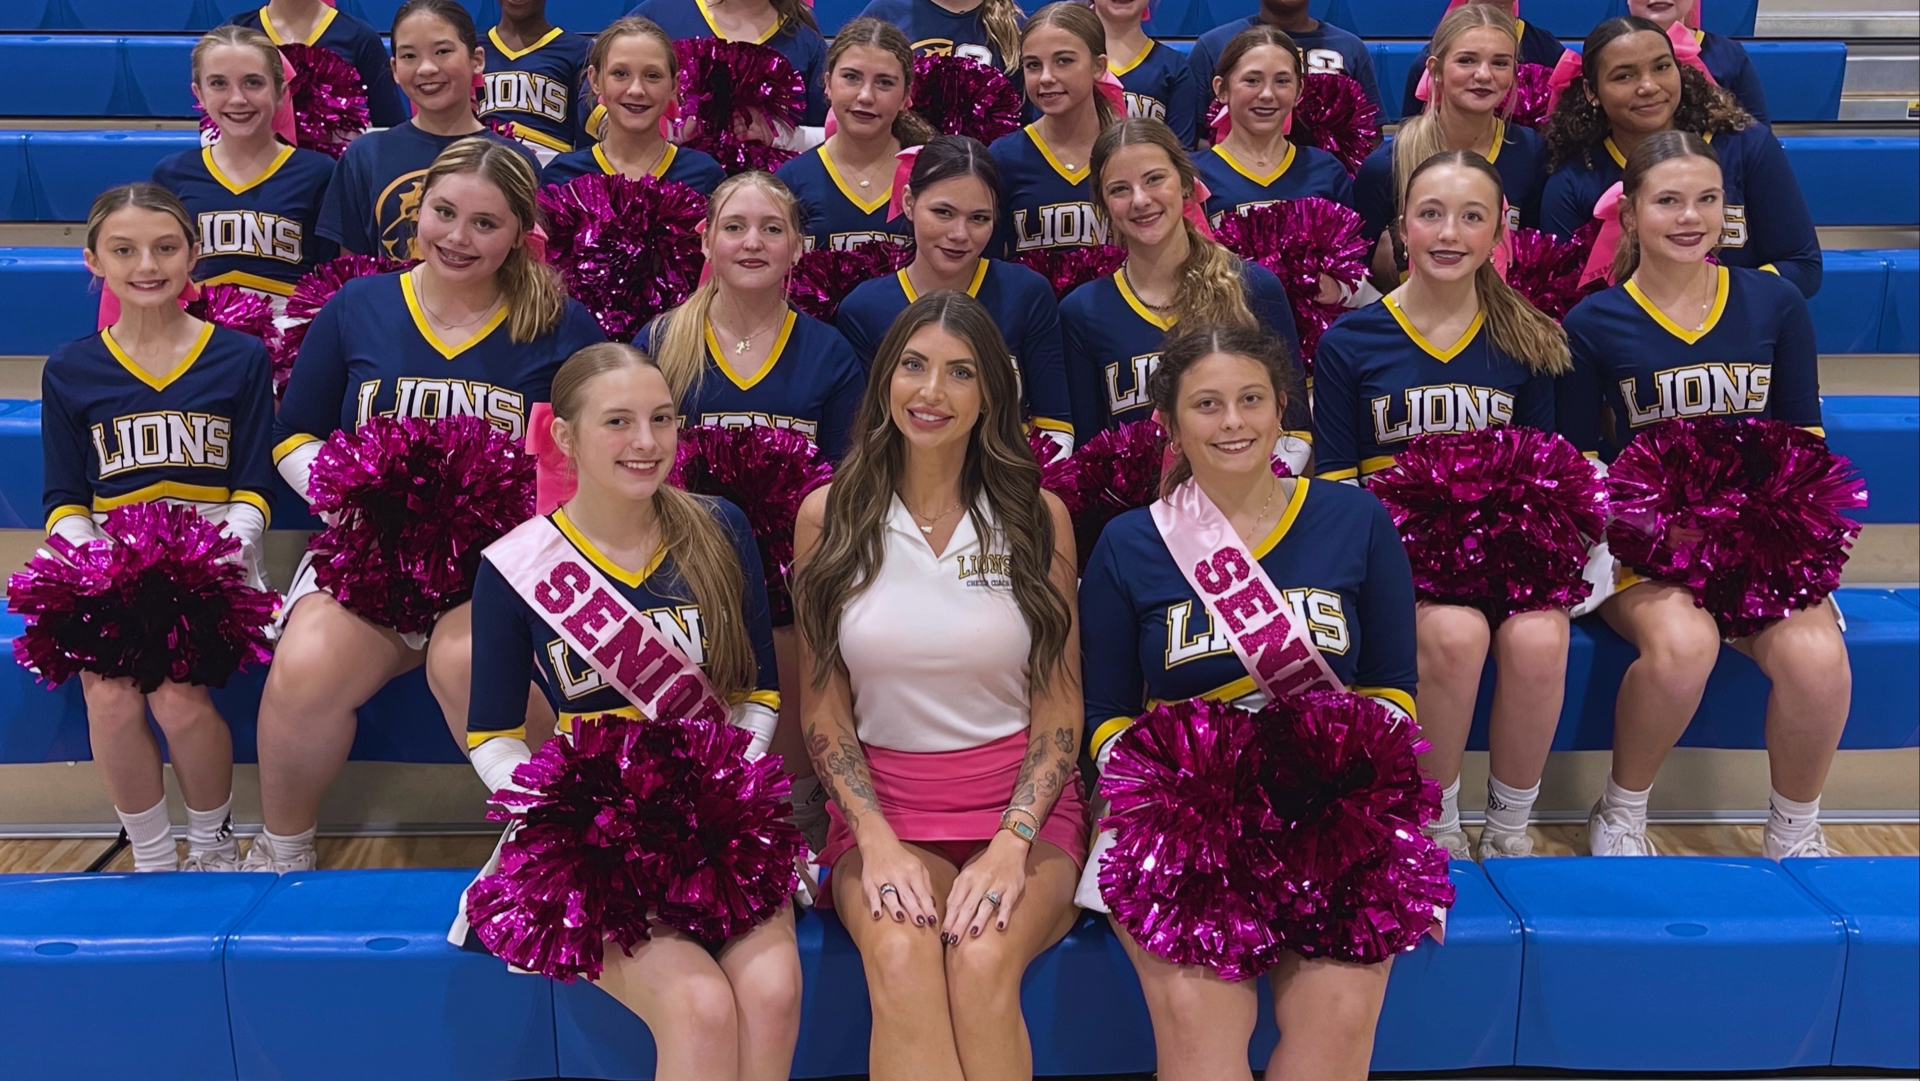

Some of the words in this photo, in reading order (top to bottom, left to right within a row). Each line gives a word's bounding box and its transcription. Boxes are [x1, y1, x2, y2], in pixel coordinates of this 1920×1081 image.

[477, 70, 568, 123] IONS
[197, 209, 303, 265] IONS
[1014, 201, 1111, 251] LION
[355, 377, 526, 442] LIONS
[1371, 383, 1515, 444] LIONS
[1619, 362, 1772, 428] LIONS
[91, 410, 231, 480] LIONS
[957, 554, 1012, 579] LIONS
